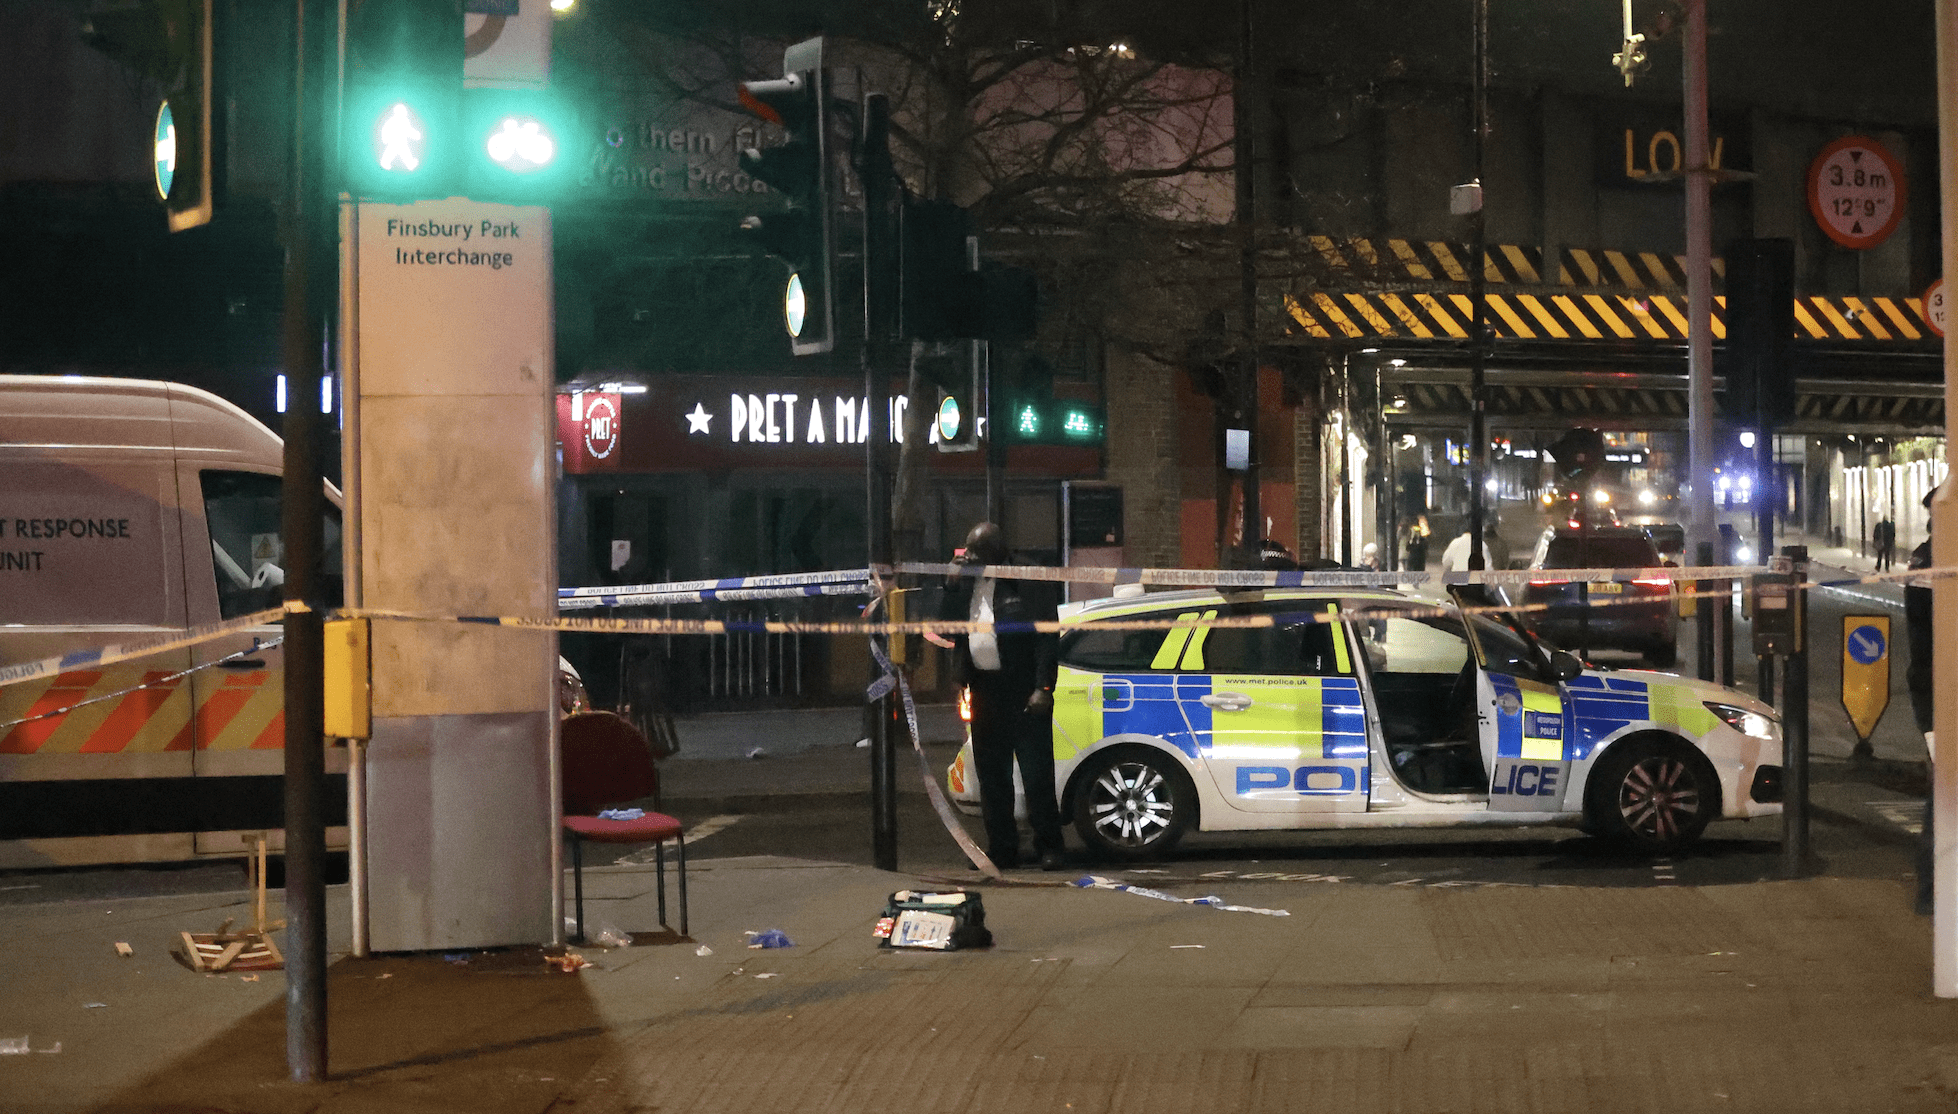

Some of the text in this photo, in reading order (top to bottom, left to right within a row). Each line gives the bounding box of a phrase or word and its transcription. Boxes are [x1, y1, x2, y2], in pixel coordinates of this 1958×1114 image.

[387, 219, 521, 241] Finsbury Park
[396, 246, 514, 270] Interchange
[591, 417, 612, 440] PRET
[731, 394, 799, 444] PRET
[807, 397, 827, 444] A
[16, 518, 130, 540] RESPONSE
[1225, 677, 1308, 686] www.met.police.uk
[1540, 727, 1557, 736] POLICE
